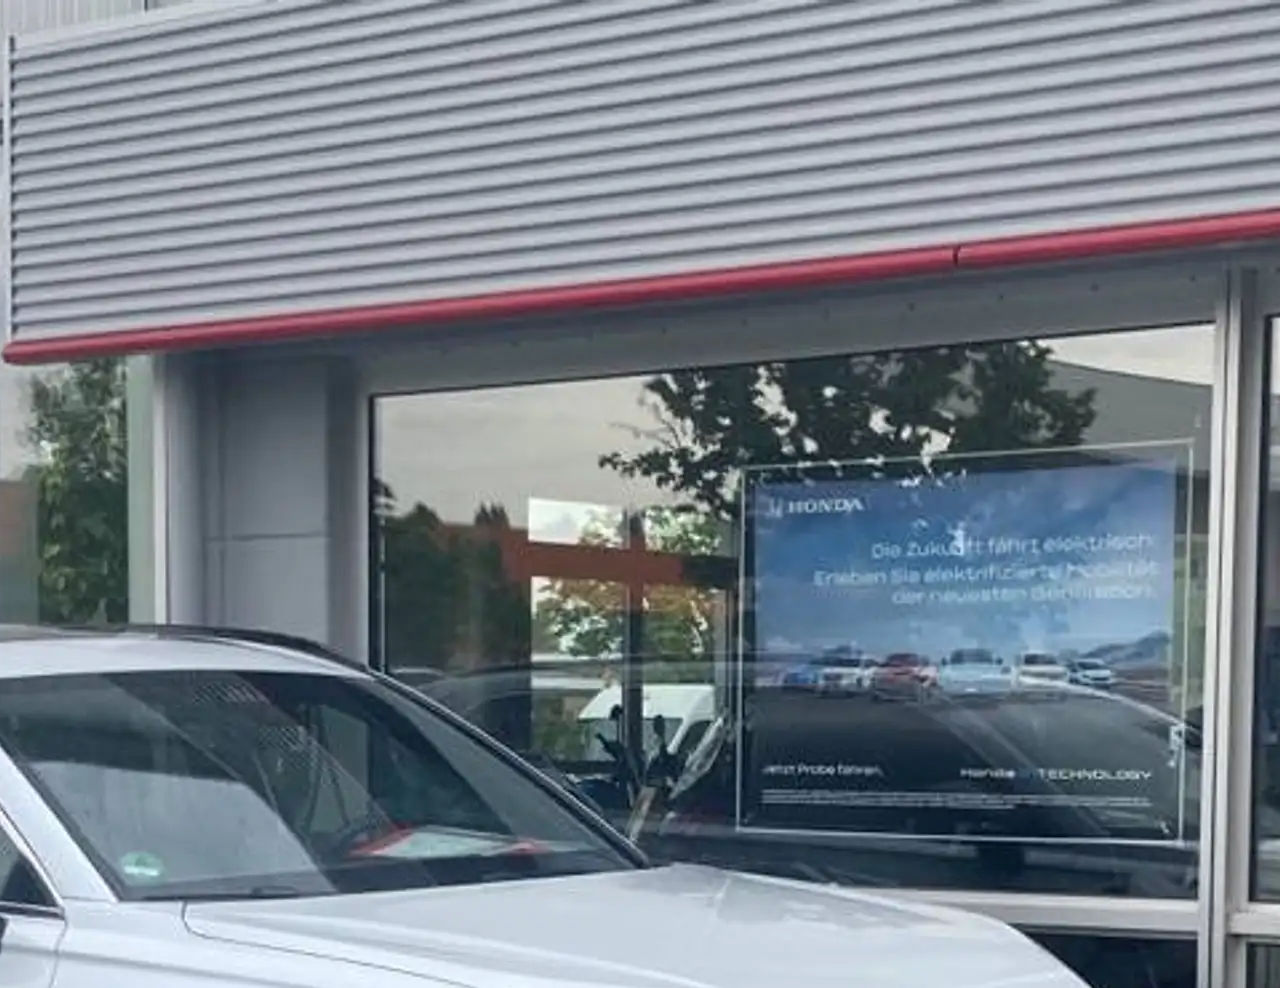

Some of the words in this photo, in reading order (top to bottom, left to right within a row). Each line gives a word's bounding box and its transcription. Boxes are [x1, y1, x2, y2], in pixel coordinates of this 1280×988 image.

[787, 497, 865, 516] HONDA
[871, 541, 903, 559] Die
[1037, 767, 1153, 781] TECHNOLOGY
